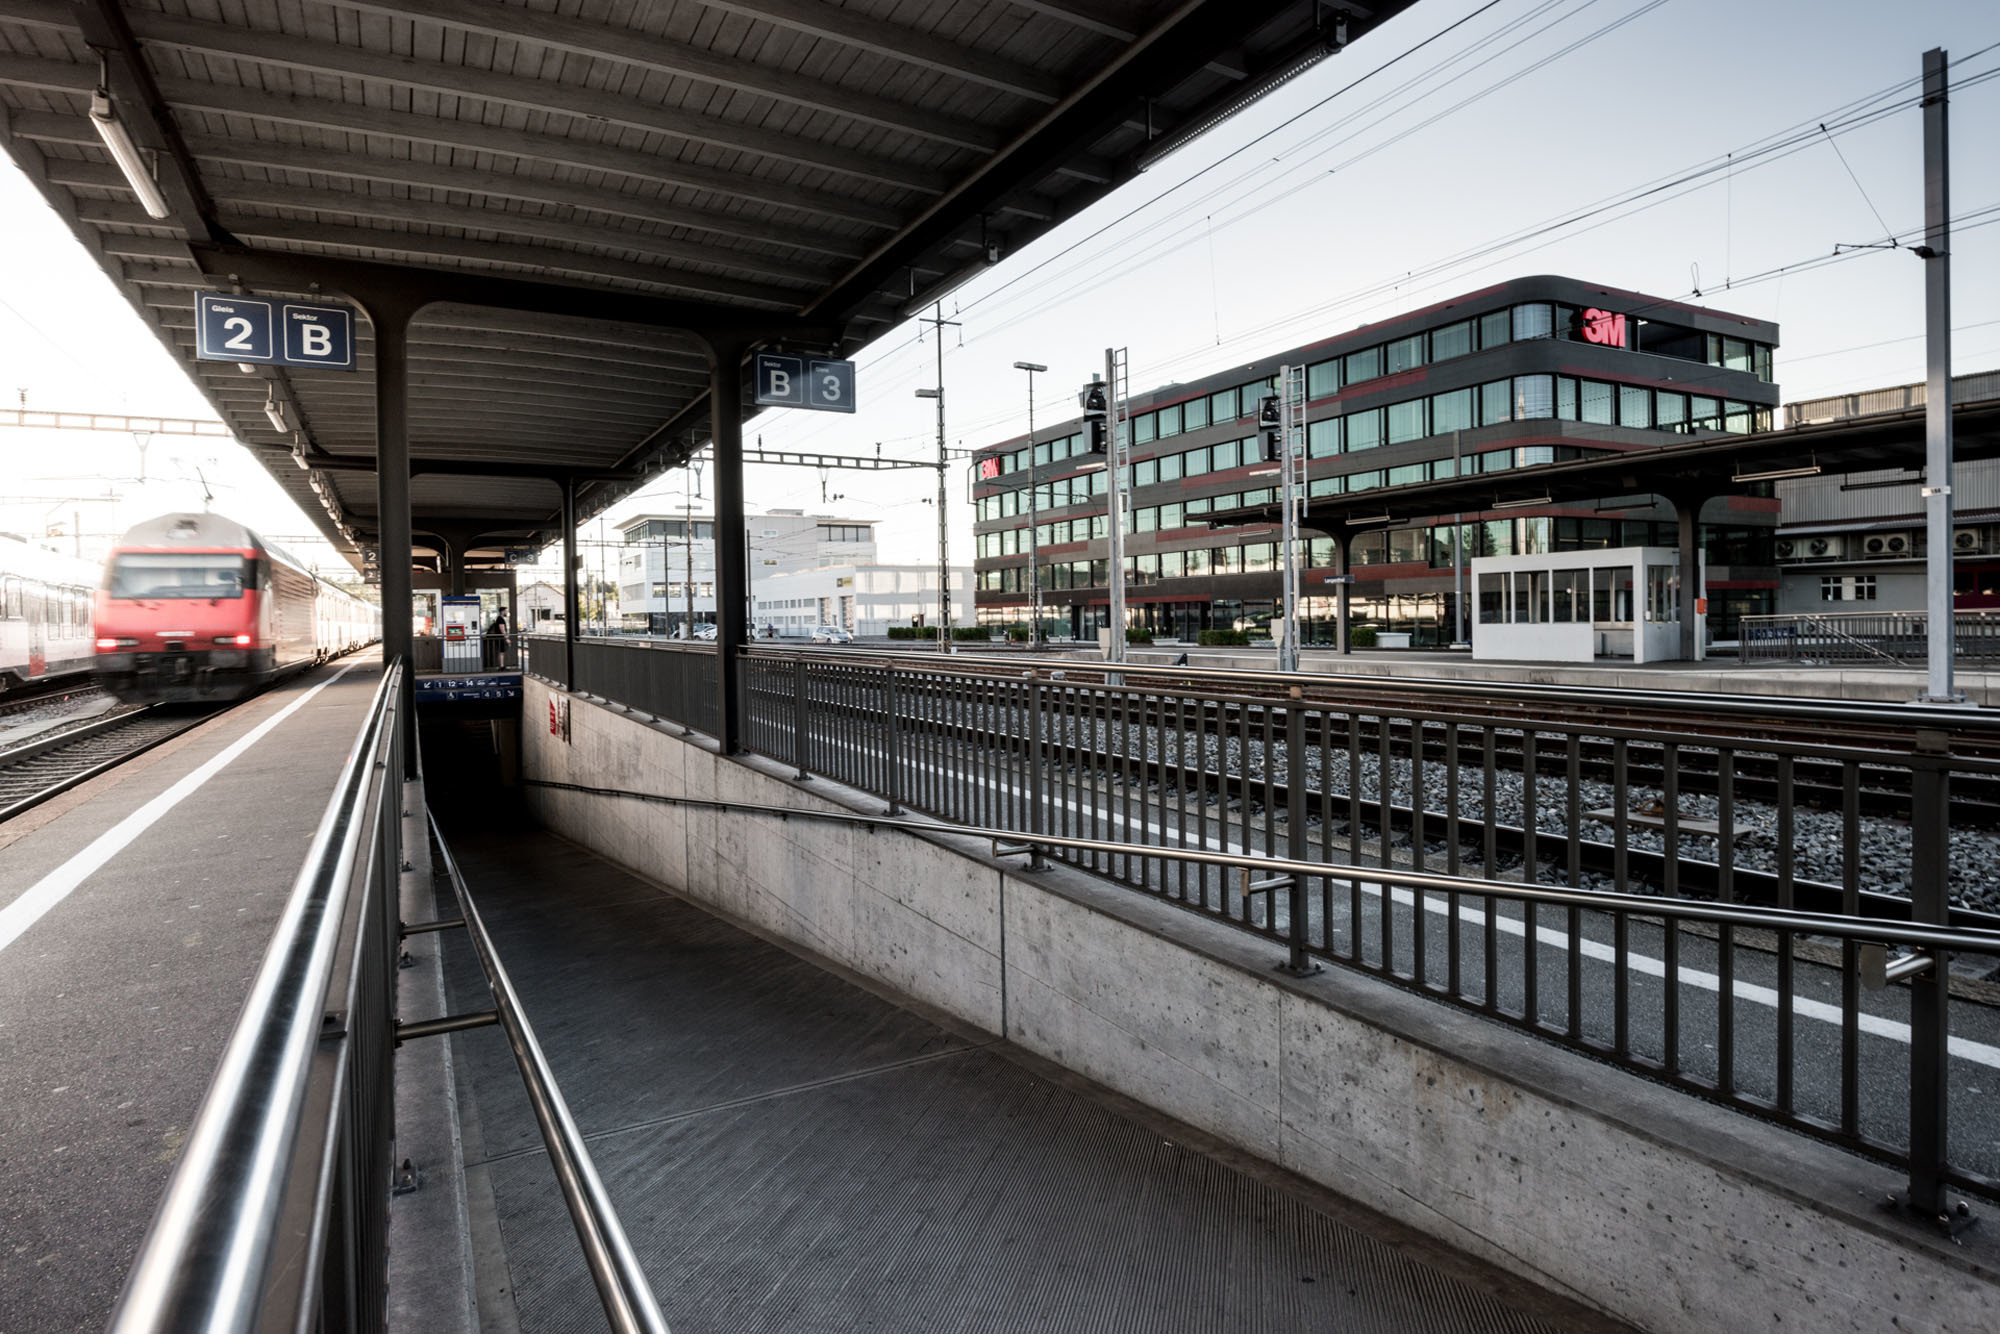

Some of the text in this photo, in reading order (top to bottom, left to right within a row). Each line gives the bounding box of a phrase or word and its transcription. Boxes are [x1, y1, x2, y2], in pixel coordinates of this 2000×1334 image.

[211, 304, 235, 313] Gleis
[292, 312, 319, 322] Sektor
[224, 317, 253, 350] 2
[302, 323, 332, 356] B
[1581, 308, 1626, 348] 3M
[770, 370, 790, 397] B
[822, 375, 841, 401] 3
[981, 456, 1000, 479] 3M
[368, 552, 377, 561] 2
[509, 553, 517, 562] C
[527, 554, 534, 562] 3
